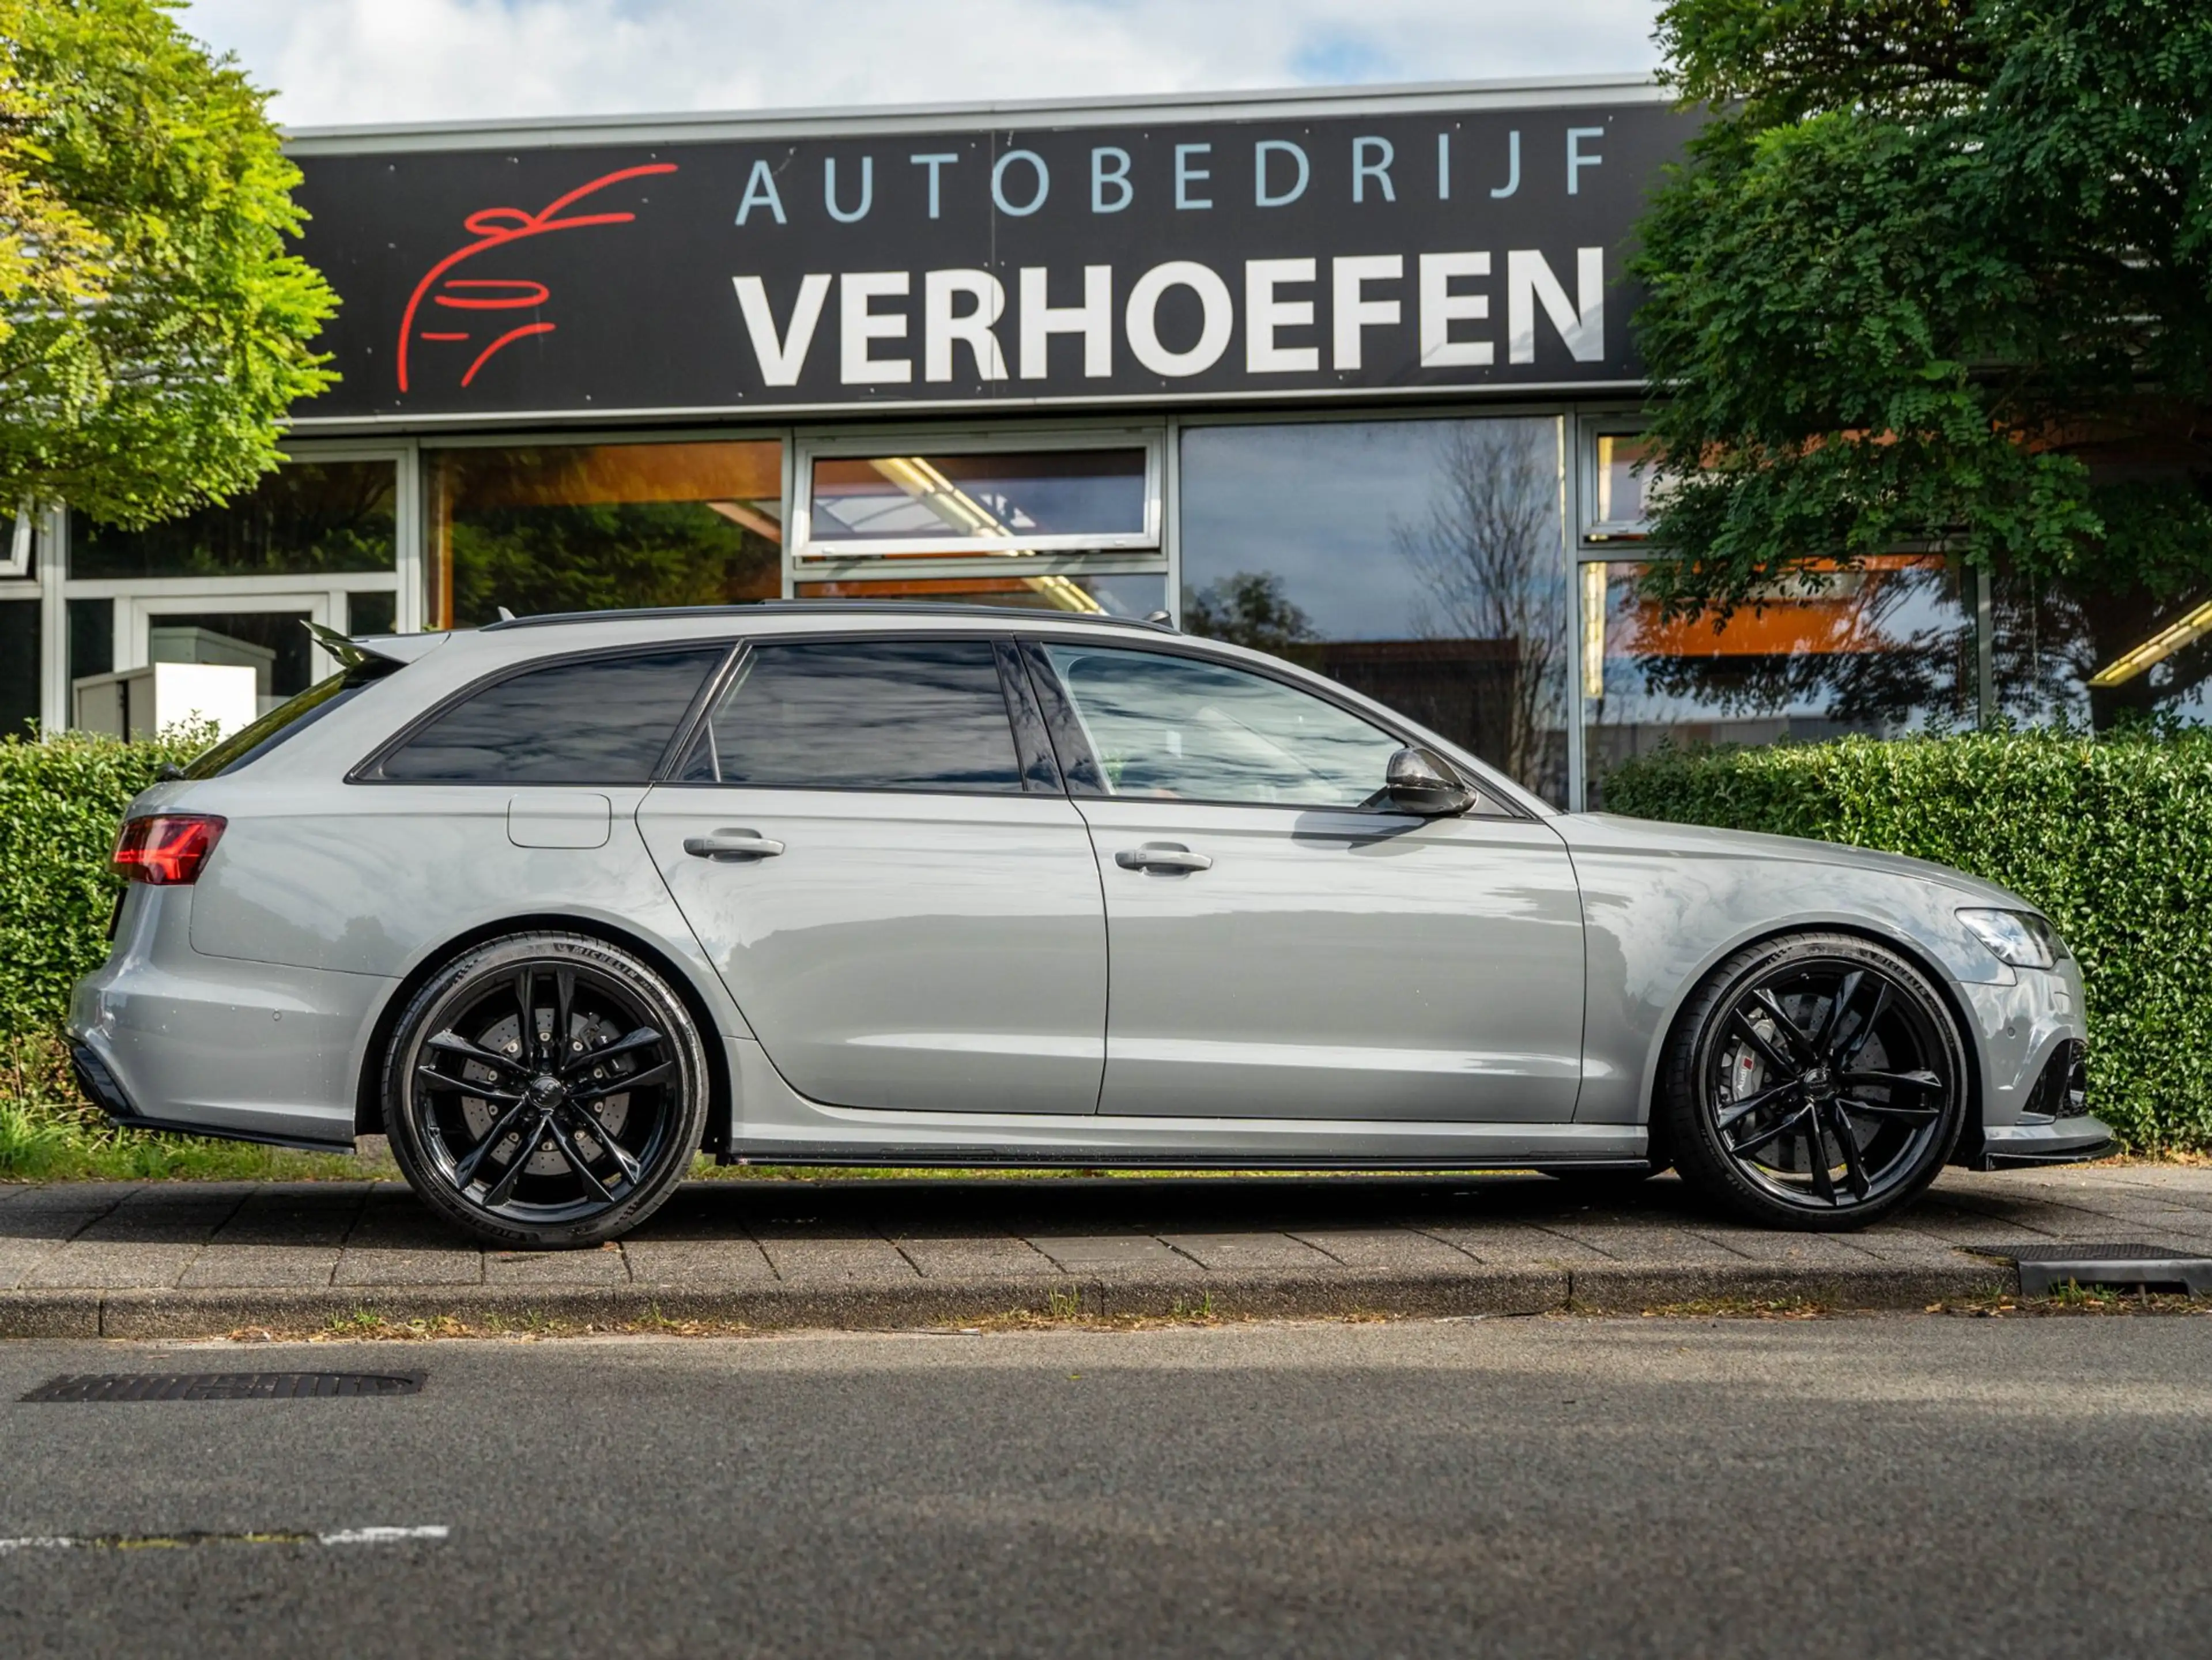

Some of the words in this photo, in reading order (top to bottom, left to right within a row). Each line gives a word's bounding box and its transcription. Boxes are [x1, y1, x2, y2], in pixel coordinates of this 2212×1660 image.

[734, 127, 1605, 225] AUTOBEDRIJF
[731, 247, 1605, 386] VERHOEFEN
[571, 945, 637, 979] MICHELIN
[1737, 1067, 1747, 1093] Audi
